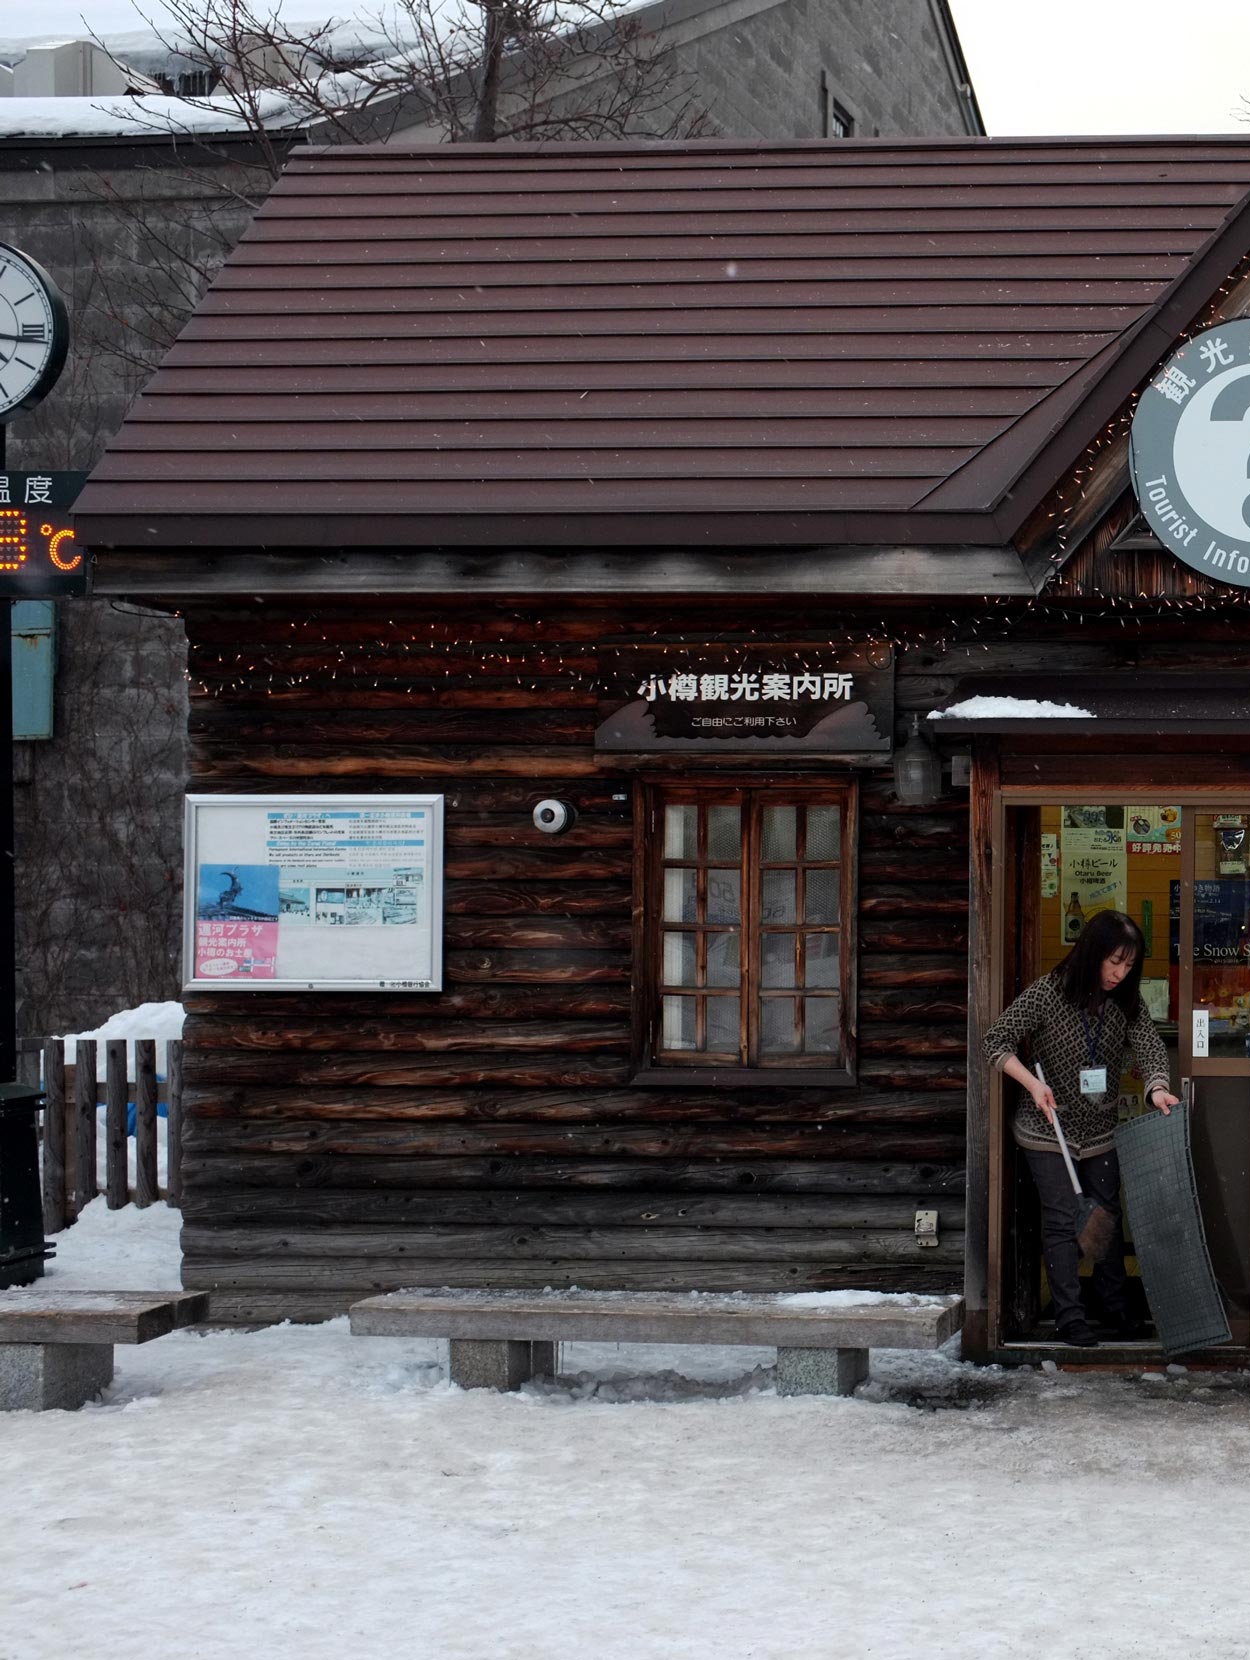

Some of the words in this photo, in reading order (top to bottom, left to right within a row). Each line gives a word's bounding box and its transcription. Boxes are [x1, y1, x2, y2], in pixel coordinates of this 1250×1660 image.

[1145, 474, 1198, 547] Tourist
[637, 672, 854, 701] 小樽観光案内所
[691, 716, 797, 727] ご自由にご利用下さい
[1069, 858, 1119, 870] 小樽ビール
[1203, 943, 1239, 957] Snow
[1196, 1018, 1205, 1048] 出入口
